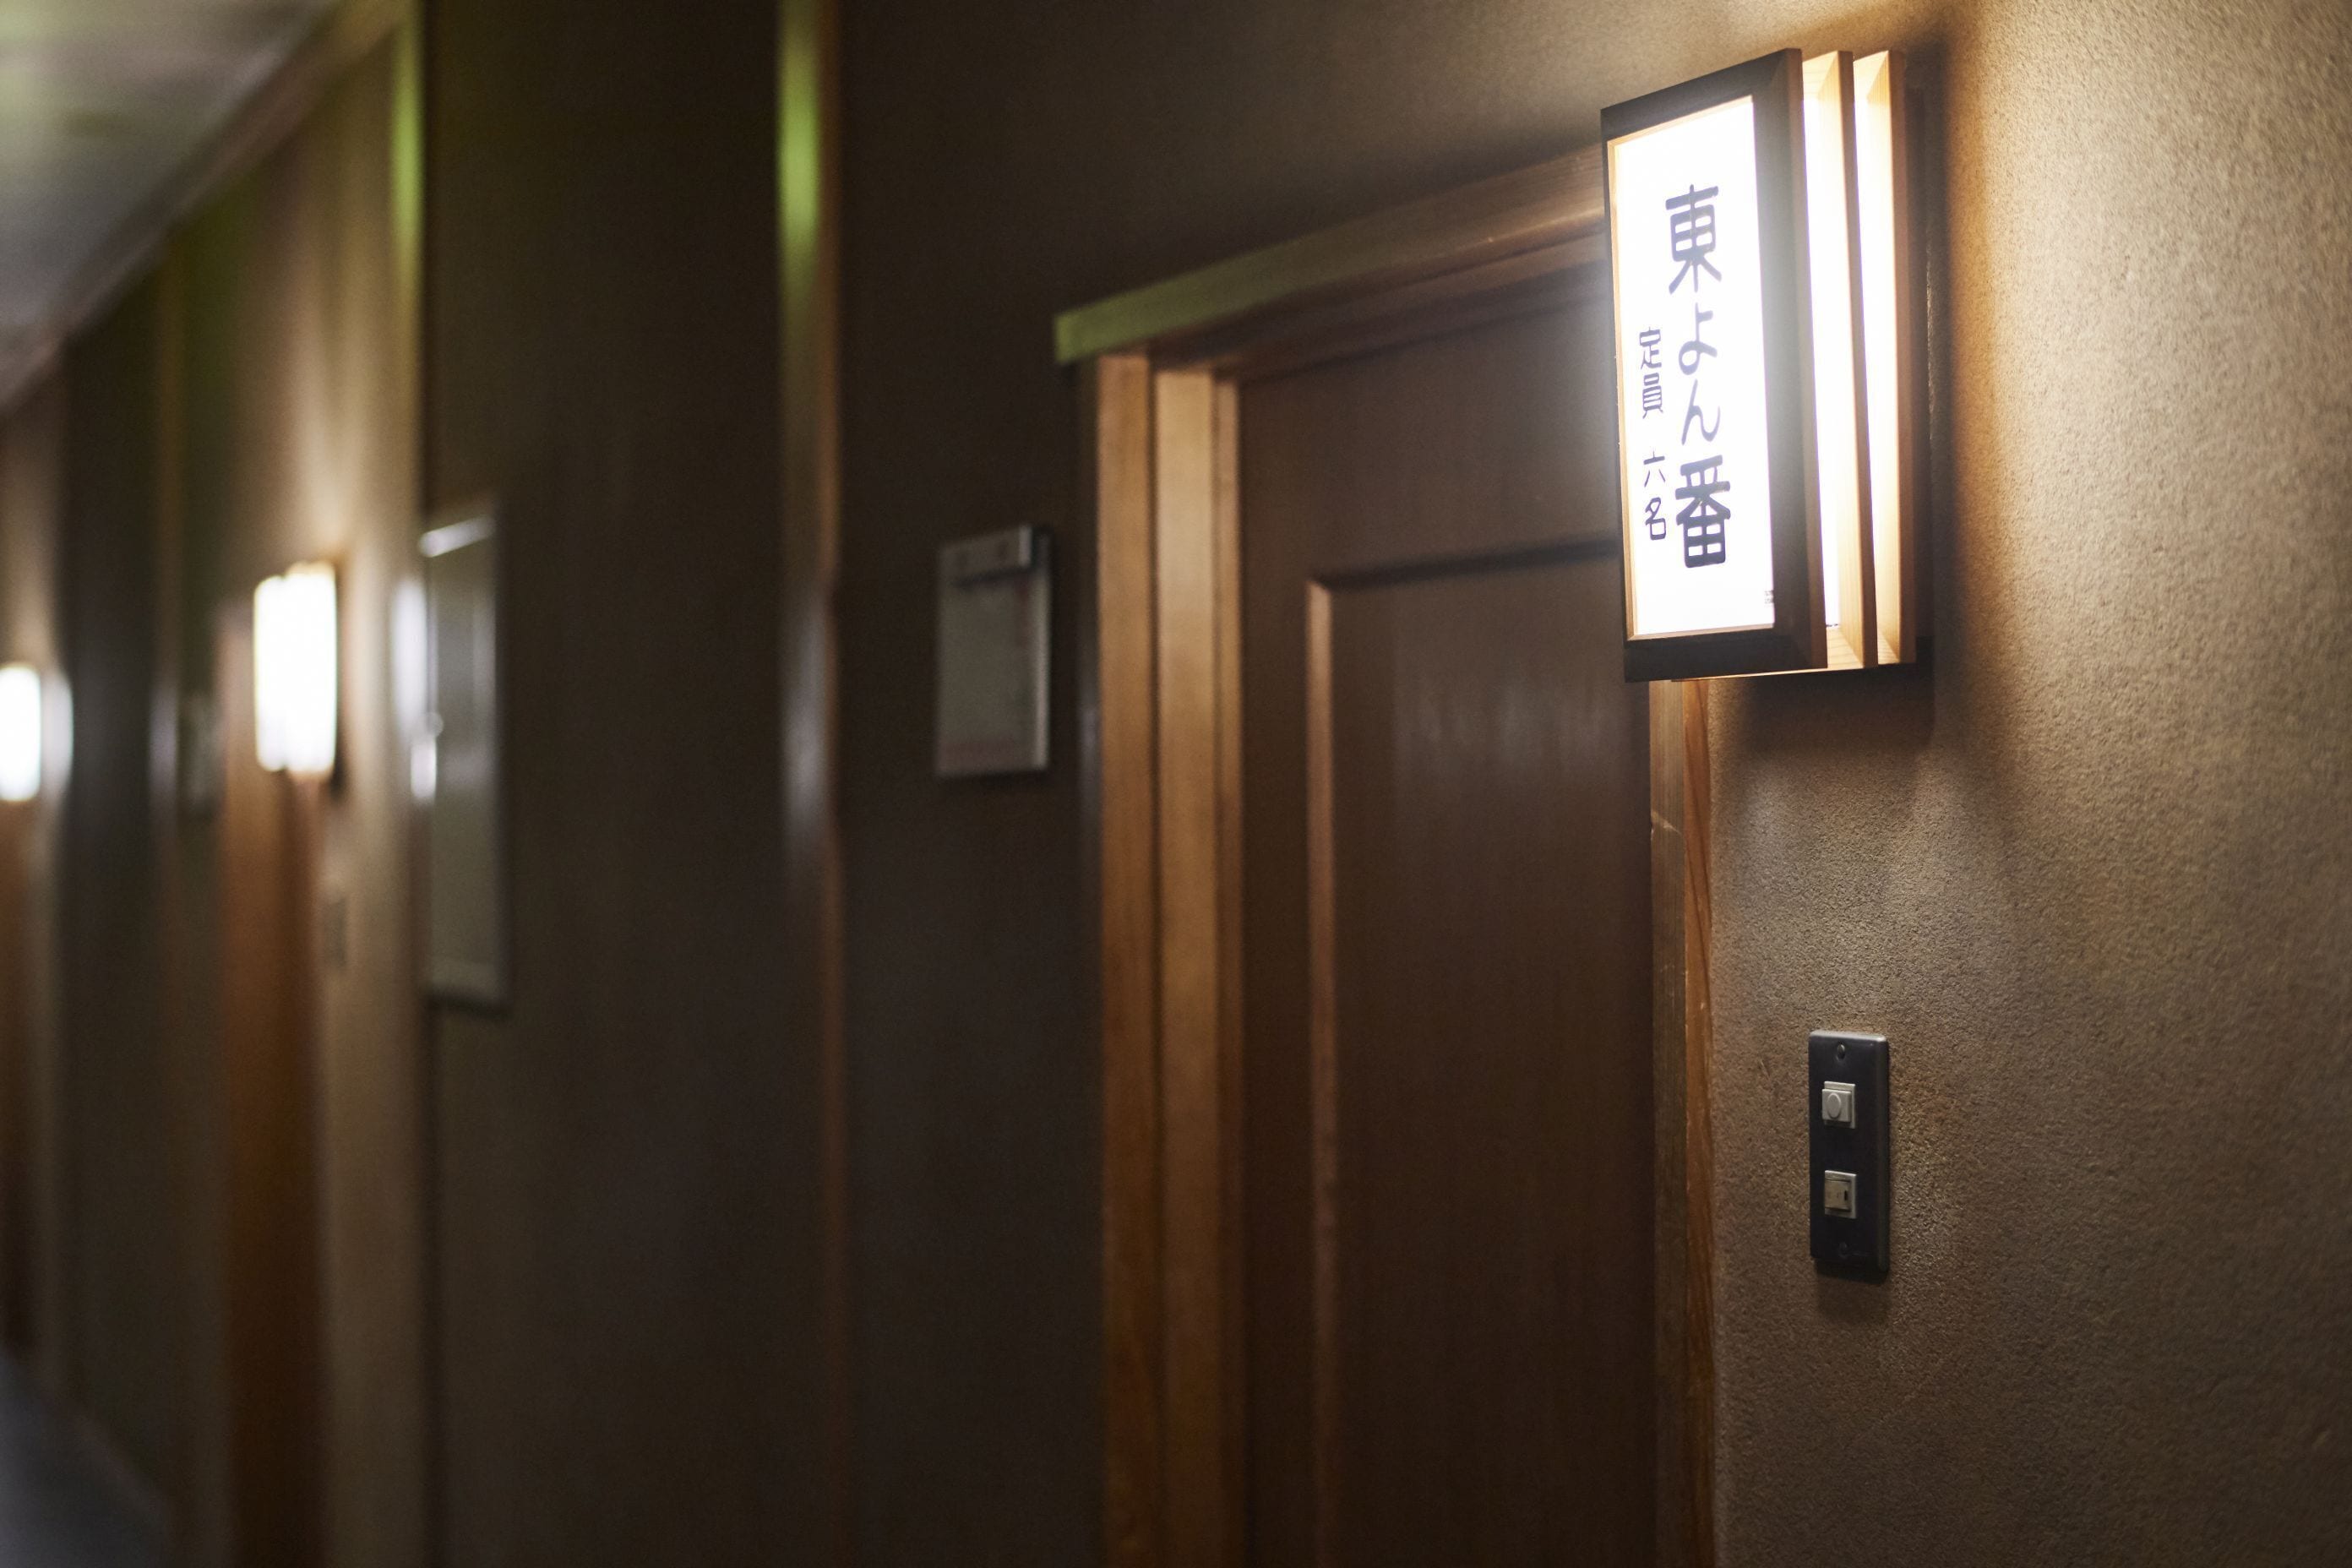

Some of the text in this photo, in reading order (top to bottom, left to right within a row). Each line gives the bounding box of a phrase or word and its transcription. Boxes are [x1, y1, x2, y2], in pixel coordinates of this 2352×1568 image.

[1638, 326, 1667, 542] 定員 六名
[1665, 184, 1732, 569] 東よん番
